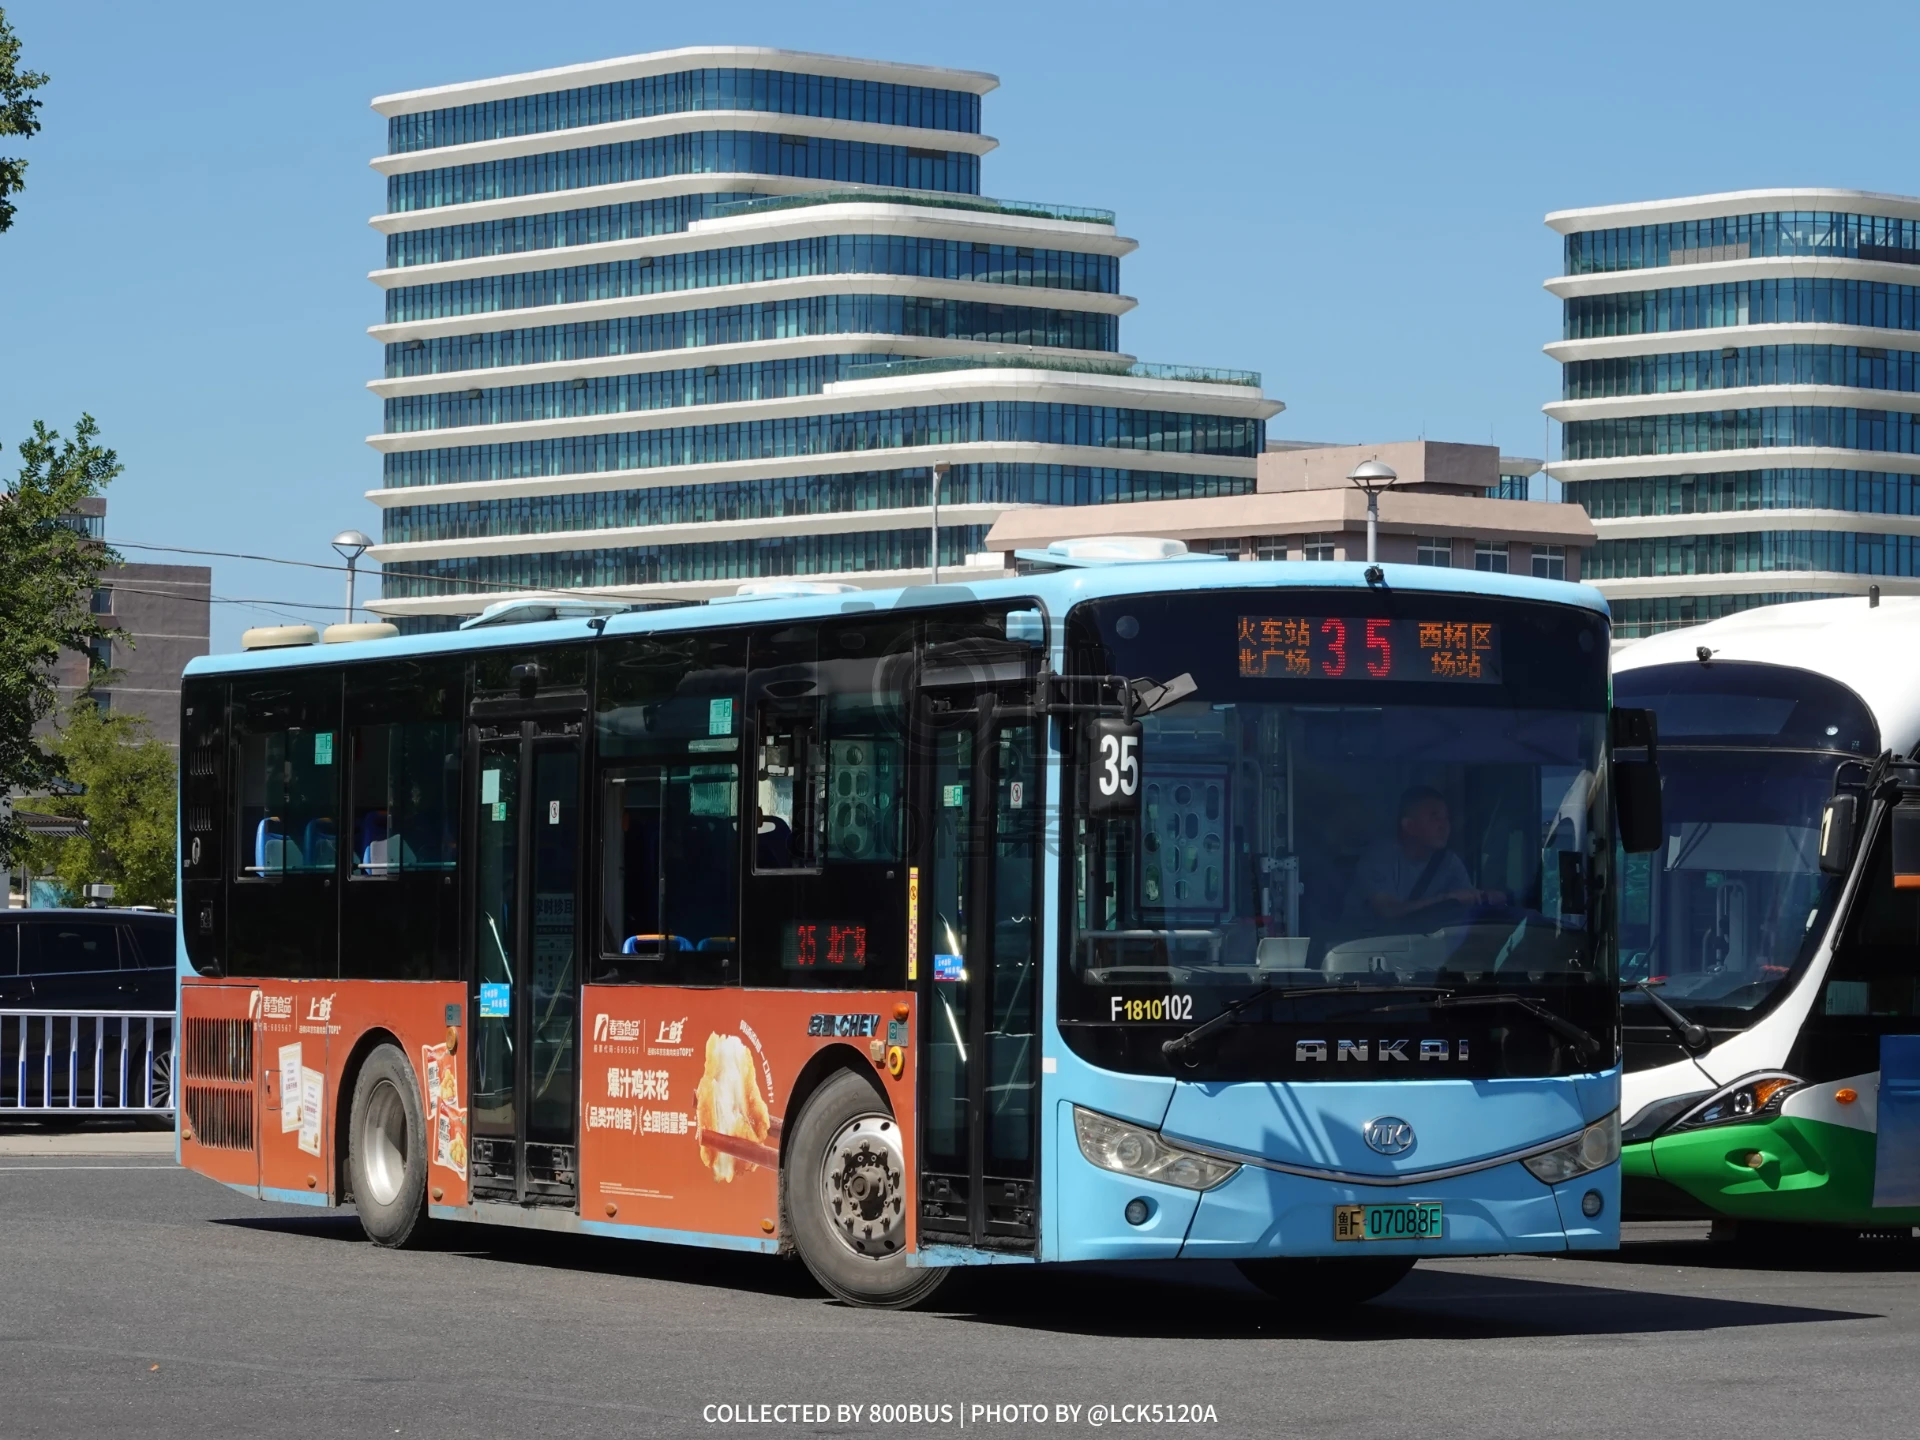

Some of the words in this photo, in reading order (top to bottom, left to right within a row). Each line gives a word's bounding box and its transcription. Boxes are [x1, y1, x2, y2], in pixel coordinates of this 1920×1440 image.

[1238, 617, 1310, 647] 火车站
[1418, 621, 1492, 650] 西拓区
[1239, 648, 1310, 675] 北广场
[1321, 618, 1391, 677] 35
[1431, 651, 1481, 678] 场站
[1099, 734, 1138, 796] 35
[797, 926, 816, 965] 35
[1111, 995, 1193, 1022] F1810102
[609, 1019, 640, 1037] 春雪食品
[1295, 1039, 1469, 1062] ANKAI
[607, 1067, 669, 1101] 爆汁鸡米花
[590, 1106, 632, 1131] 品类开创者
[643, 1110, 697, 1135] 全国销量第一
